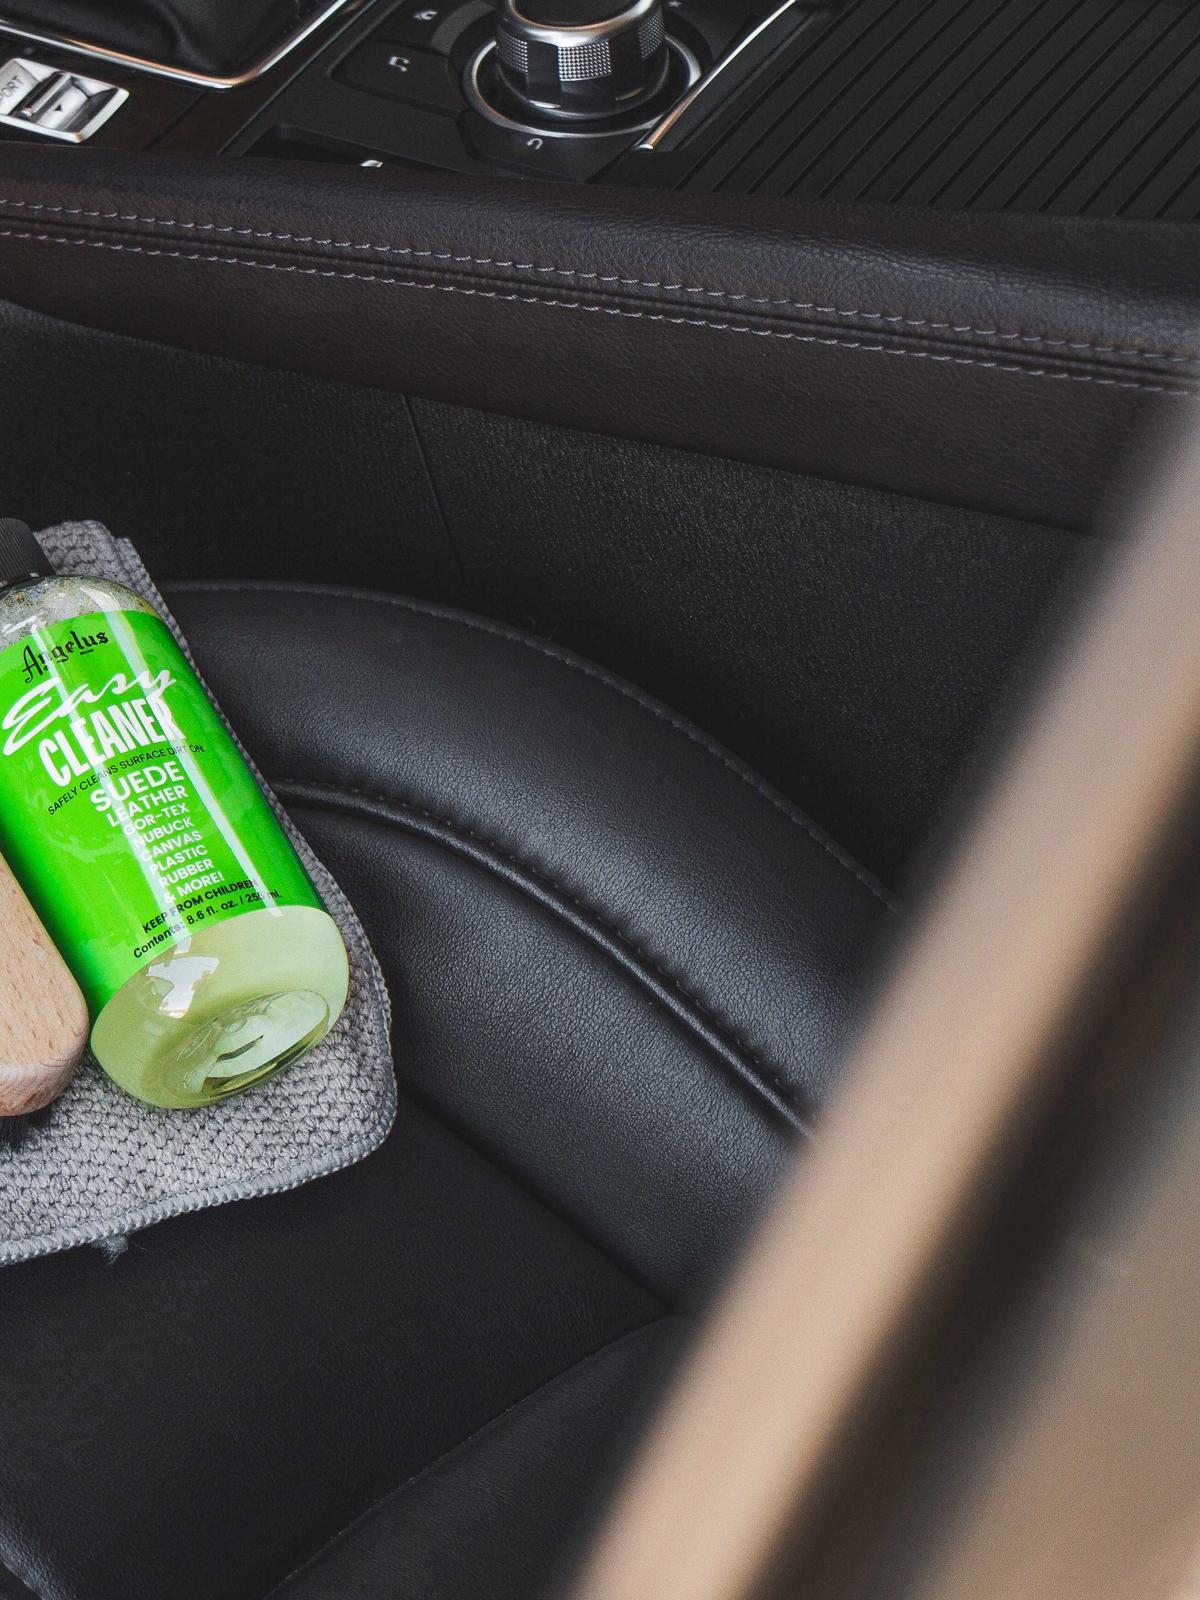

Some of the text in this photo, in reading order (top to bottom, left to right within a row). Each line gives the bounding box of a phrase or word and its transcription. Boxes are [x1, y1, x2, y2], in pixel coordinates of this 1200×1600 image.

[2, 670, 176, 756] Easy
[39, 696, 186, 787] CLEANER
[48, 787, 79, 815] SAFELY
[79, 764, 119, 791] CLEANS
[120, 749, 166, 771] SURFACE
[167, 744, 188, 756] DIRT
[90, 760, 185, 812] SUEDE
[106, 785, 189, 828] LEATHER
[124, 803, 190, 836] GOR-TEX
[133, 817, 195, 849] NUBUCK
[141, 831, 202, 862] CANVAS
[149, 845, 208, 876] PLASTIC
[158, 858, 214, 889] RUBBER
[163, 871, 225, 904] & MORE!
[133, 922, 186, 959] Contents:
[186, 909, 205, 925] 8.6
[205, 905, 218, 917] fl.
[220, 899, 239, 911] oz.
[142, 911, 169, 934] KEEP
[169, 894, 204, 917] FROM
